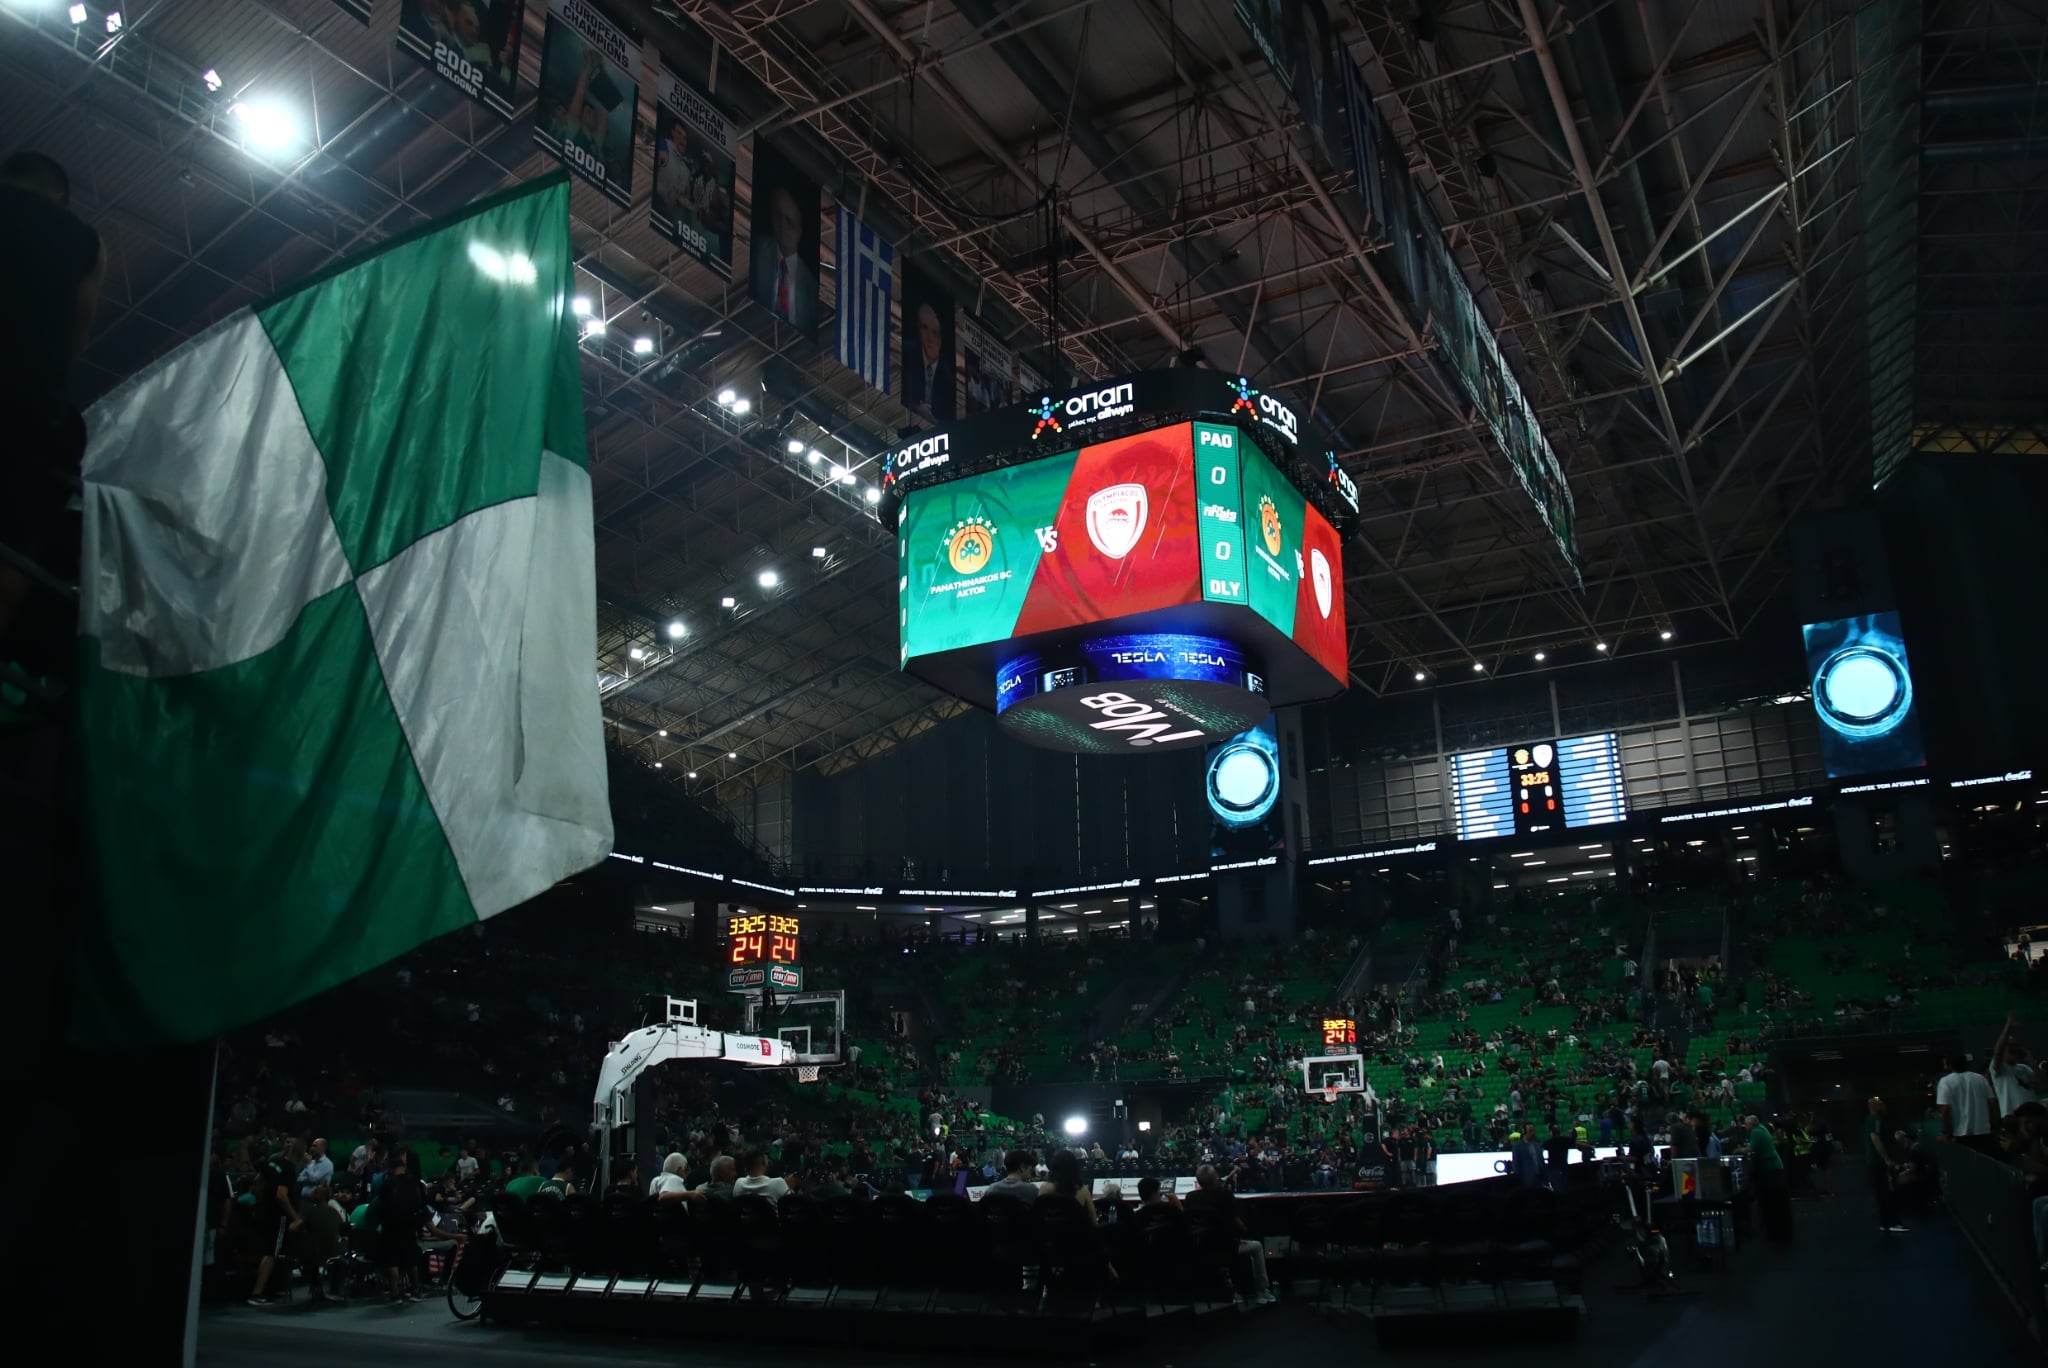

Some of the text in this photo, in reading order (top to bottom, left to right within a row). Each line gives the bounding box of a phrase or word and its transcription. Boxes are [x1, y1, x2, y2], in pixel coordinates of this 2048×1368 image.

[563, 5, 629, 68] CHAMPIONS
[569, 0, 626, 53] EUROPEAN
[434, 41, 484, 89] 2002
[437, 62, 478, 98] BOLOGNA
[674, 82, 724, 132] EUROPEAN
[670, 92, 726, 146] CHAMPIONS
[564, 139, 605, 180] 2000
[678, 220, 707, 253] 1996
[1097, 404, 1133, 420] allwyn
[1201, 431, 1232, 448] PAO
[1035, 526, 1057, 552] VS
[930, 574, 999, 595] PANATHINAIKOS
[956, 586, 985, 599] AKTOR
[1210, 579, 1240, 597] OLY
[1112, 651, 1166, 663] TESLA
[1178, 651, 1225, 667] TESLA
[1520, 772, 1549, 787] 33:25
[729, 915, 766, 935] 33:25
[769, 915, 798, 934] 33:25
[733, 936, 762, 961] 24
[773, 936, 796, 960] 24
[736, 1042, 760, 1050] COSMOTE
[1326, 1030, 1344, 1043] 24
